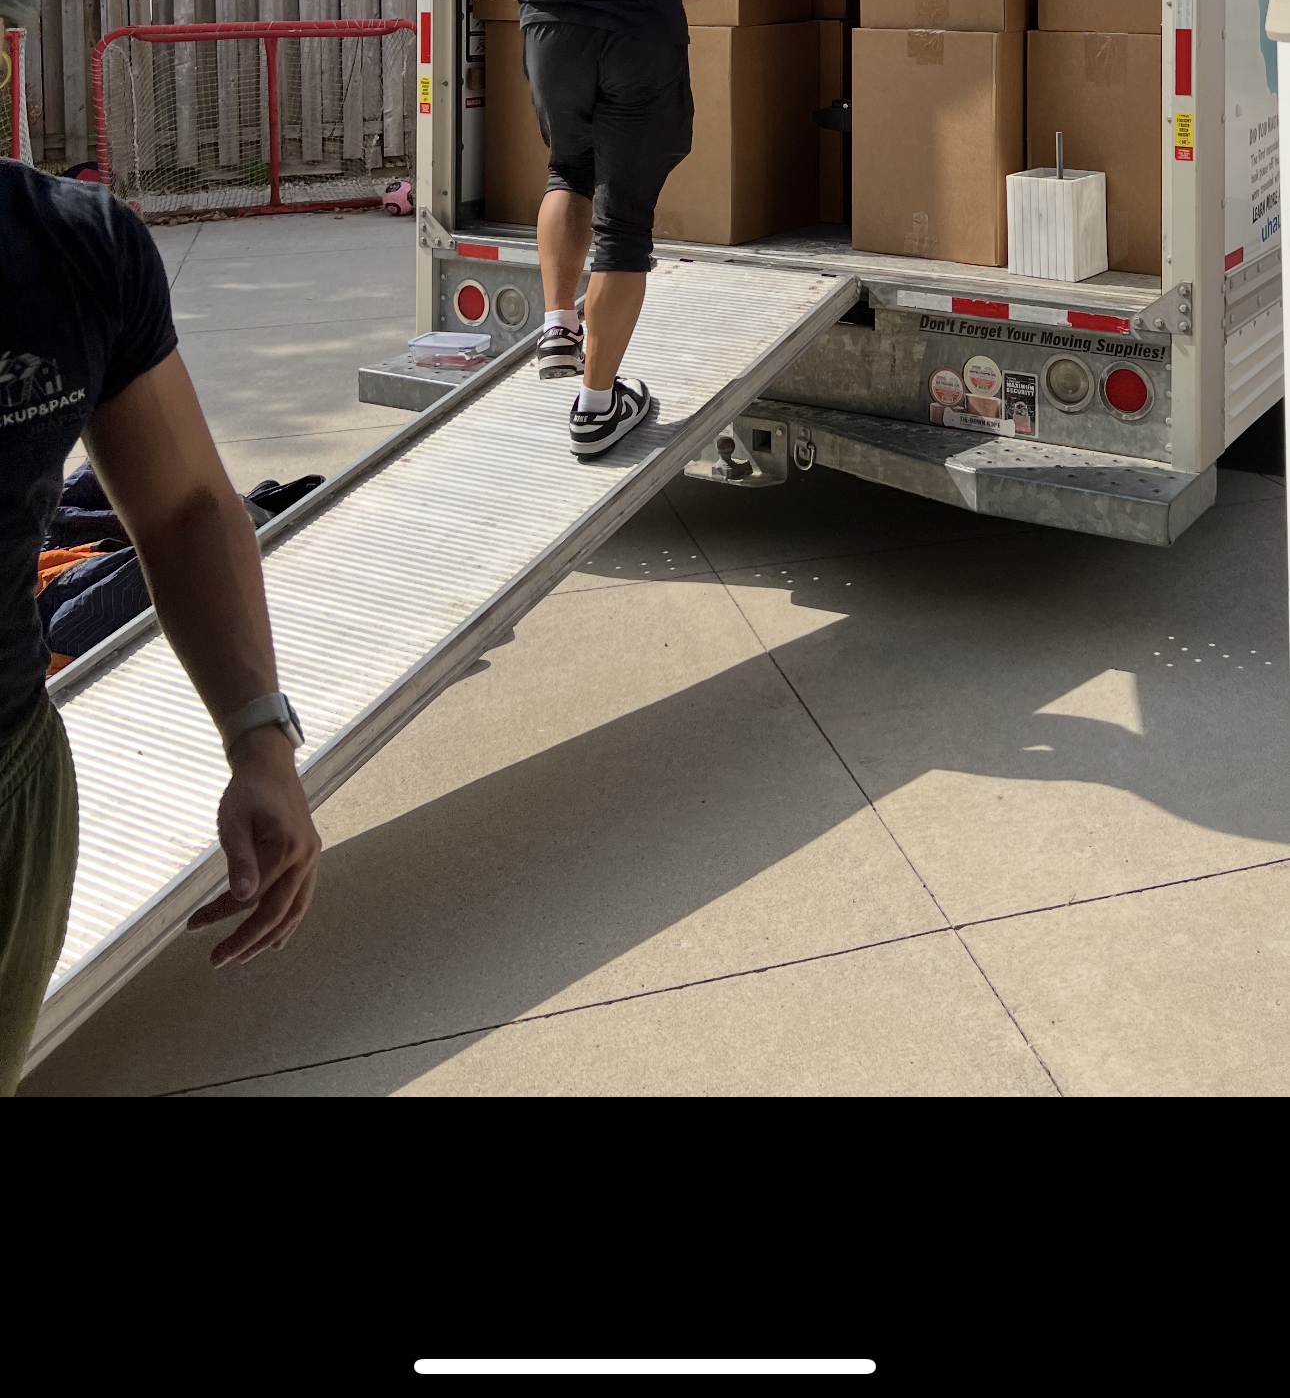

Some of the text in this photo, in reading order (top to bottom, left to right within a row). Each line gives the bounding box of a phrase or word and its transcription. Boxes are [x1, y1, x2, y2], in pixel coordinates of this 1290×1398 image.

[920, 314, 1166, 360] Don't Forget Your Moving Supplies!
[0, 388, 86, 426] KUP&PACK
